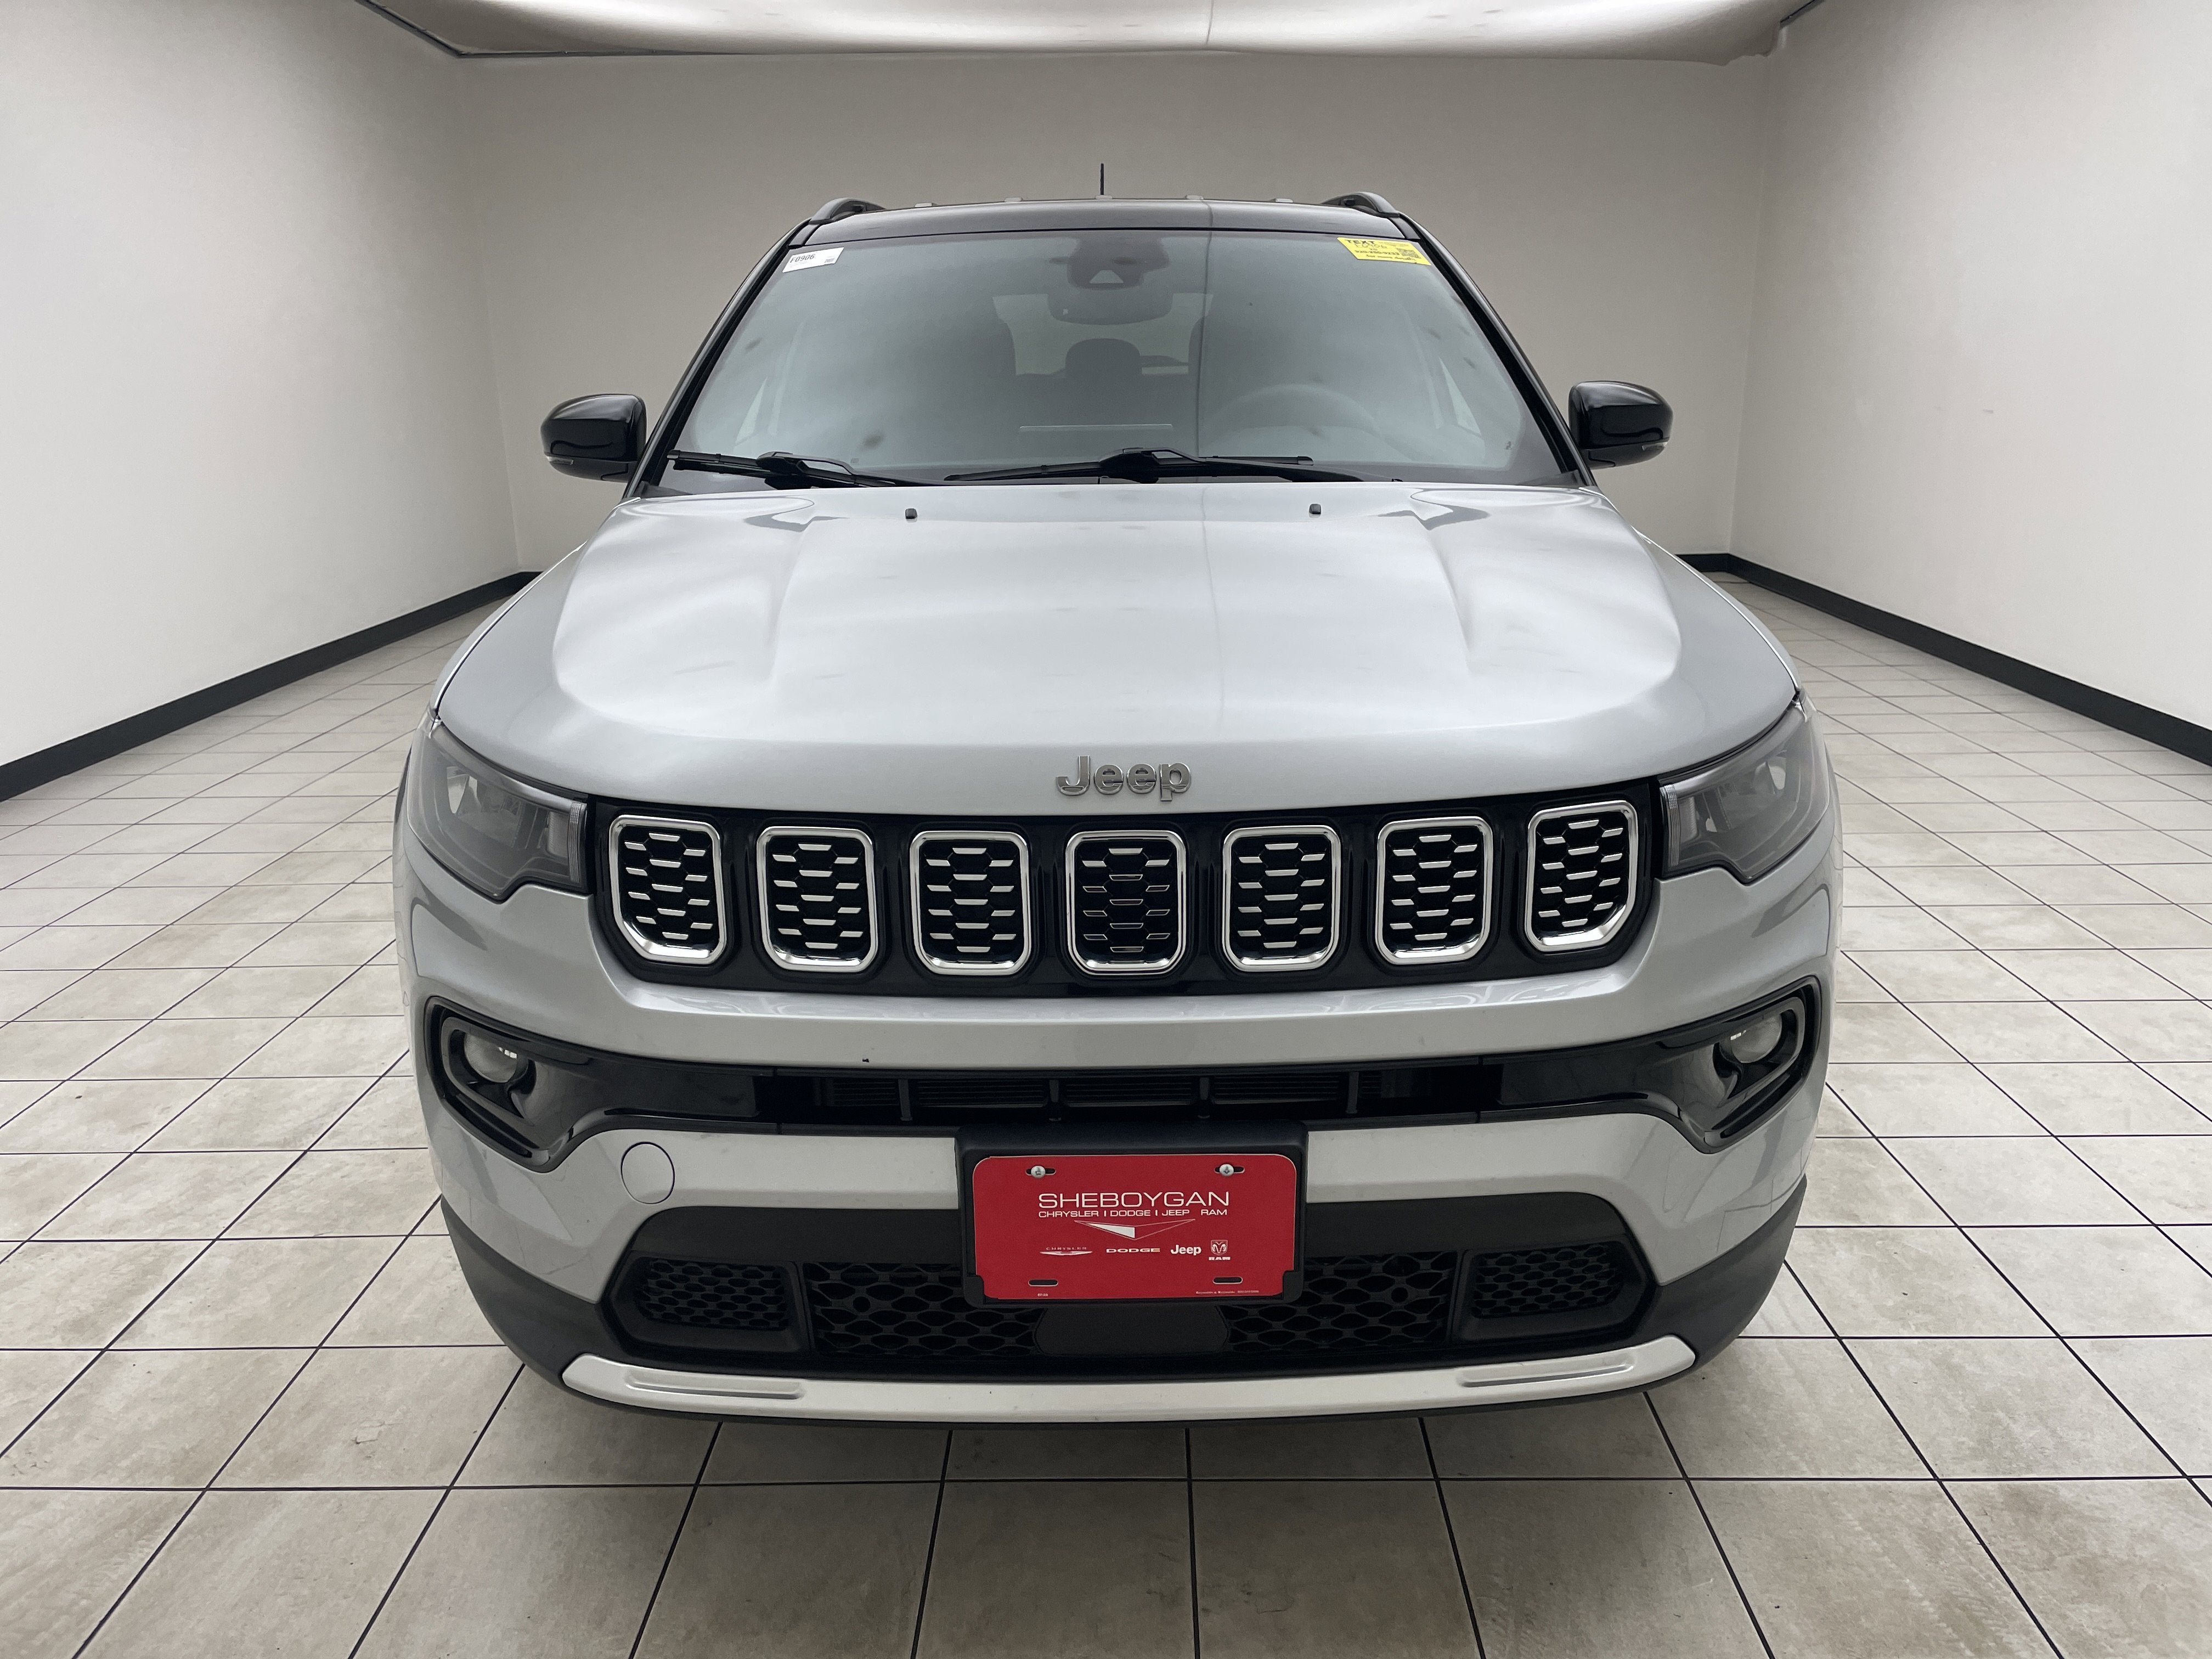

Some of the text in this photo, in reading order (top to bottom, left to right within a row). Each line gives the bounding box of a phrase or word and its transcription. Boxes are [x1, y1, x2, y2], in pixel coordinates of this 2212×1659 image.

[790, 253, 816, 263] F0906
[1056, 755, 1191, 801] Jeep
[1039, 1191, 1229, 1209] SHEBOYGAN
[1170, 1244, 1202, 1256] Jeep
